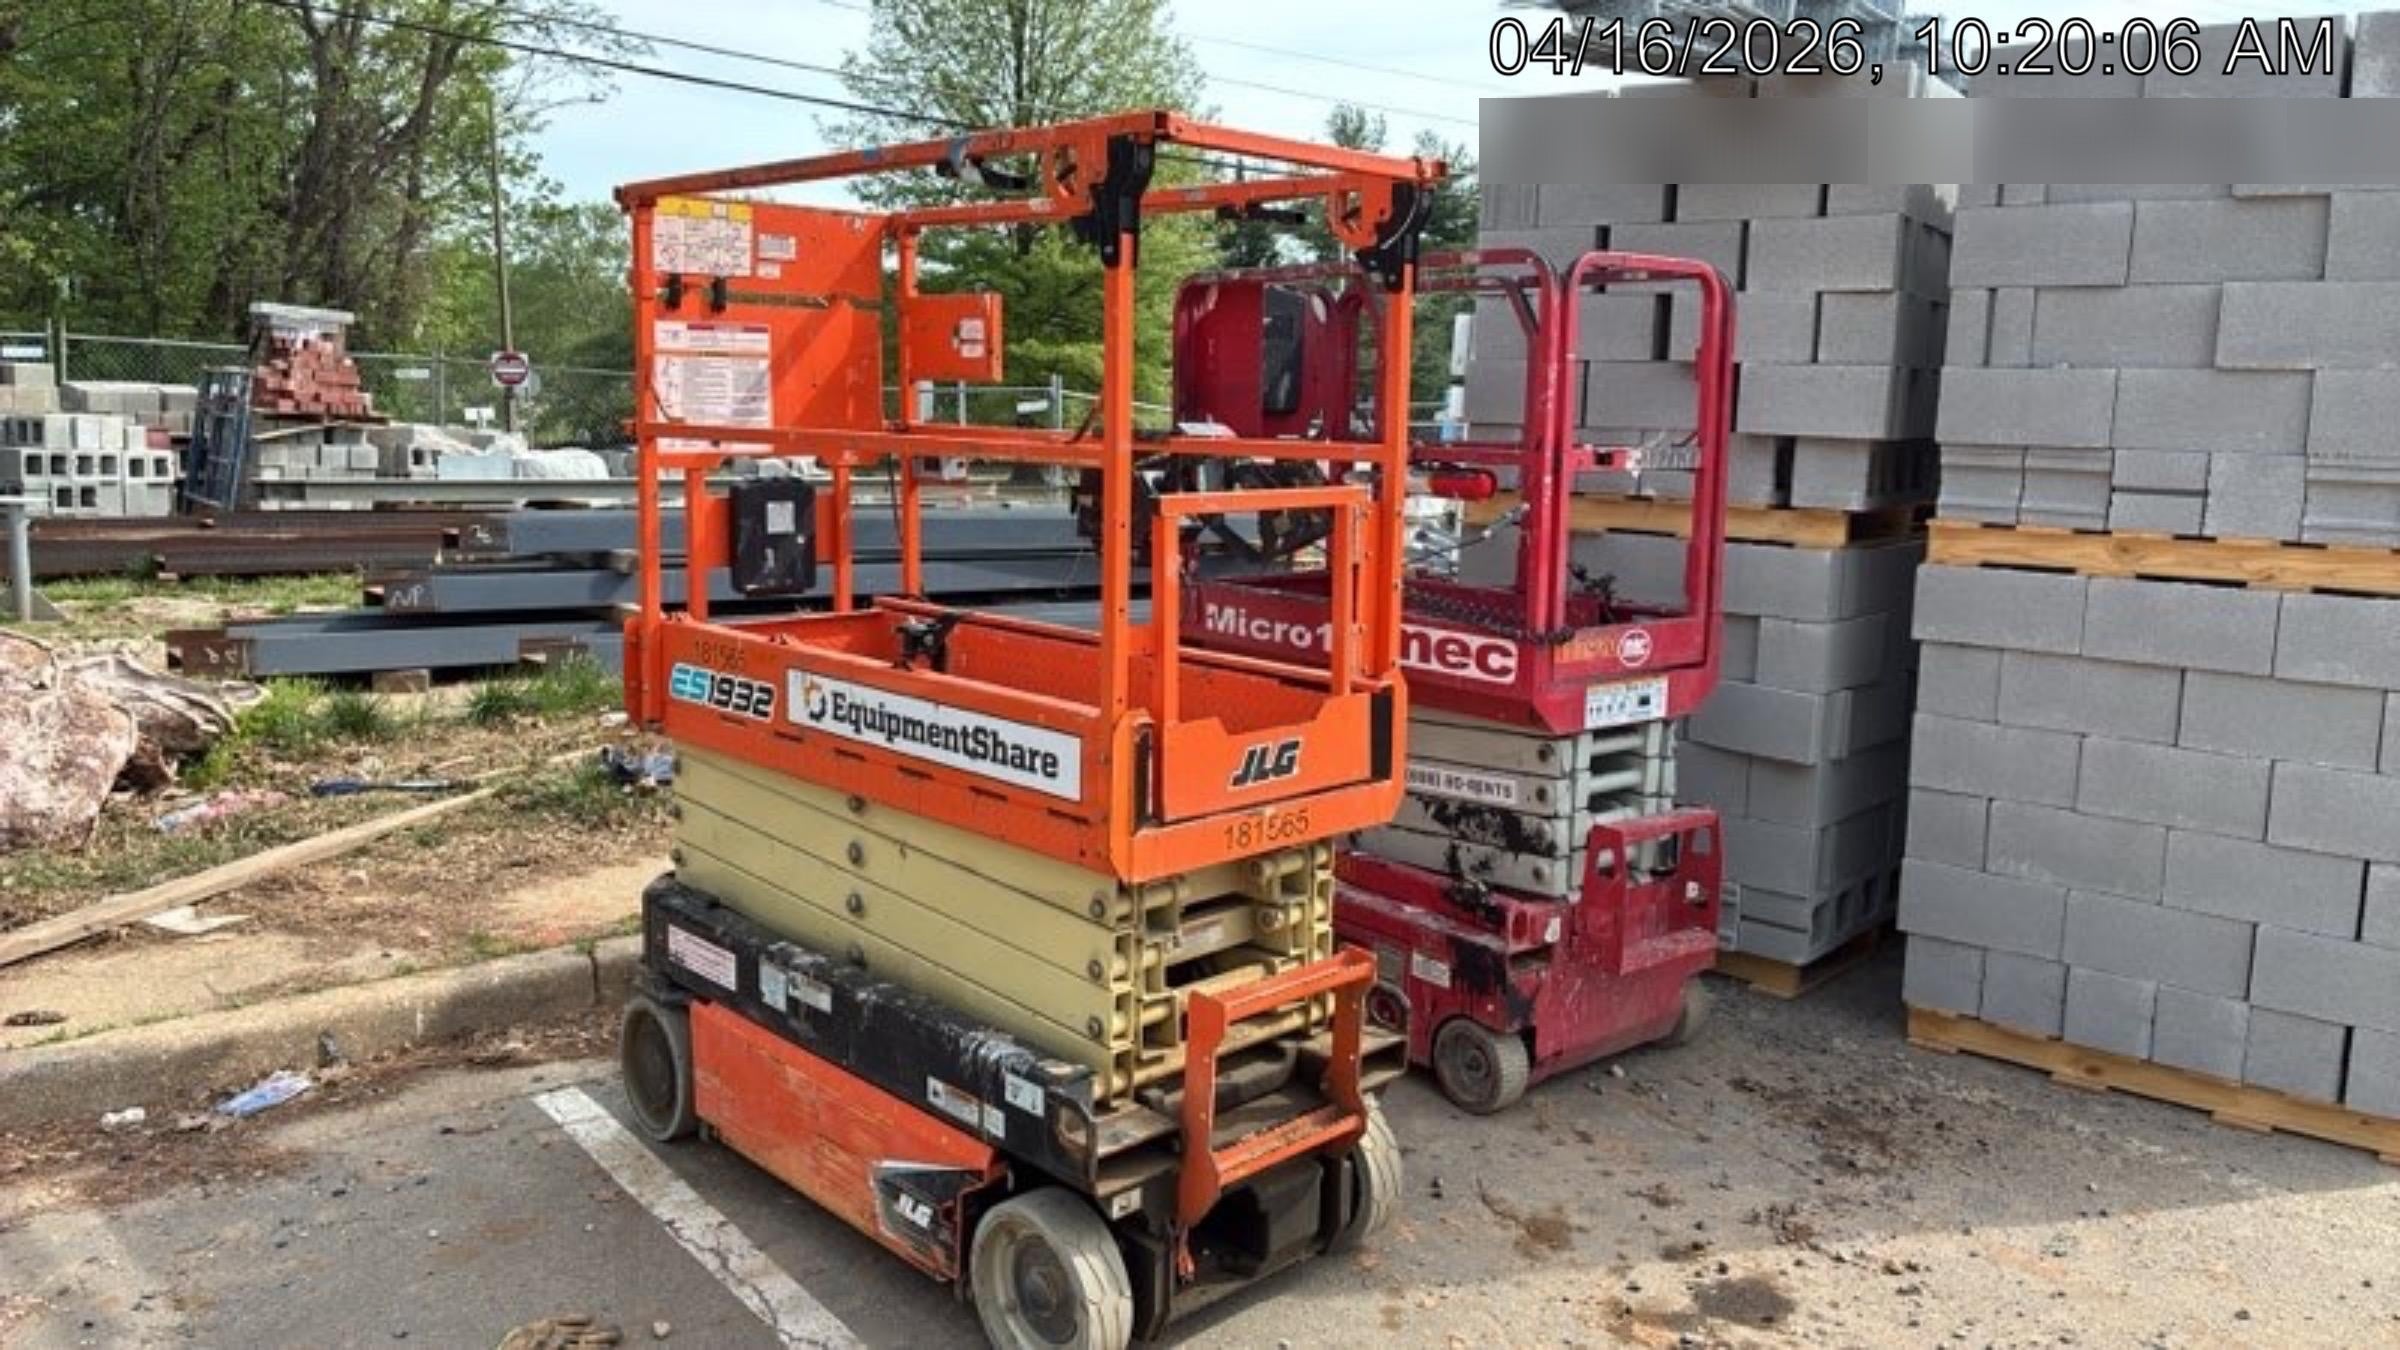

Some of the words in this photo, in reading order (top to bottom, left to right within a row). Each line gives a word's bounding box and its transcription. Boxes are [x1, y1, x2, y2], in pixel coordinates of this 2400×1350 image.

[671, 666, 775, 719] ES1932
[831, 691, 1060, 779] EquipmentShare
[1231, 739, 1301, 787] JLG
[1224, 807, 1310, 851] 181565
[893, 1192, 934, 1229] JLG
